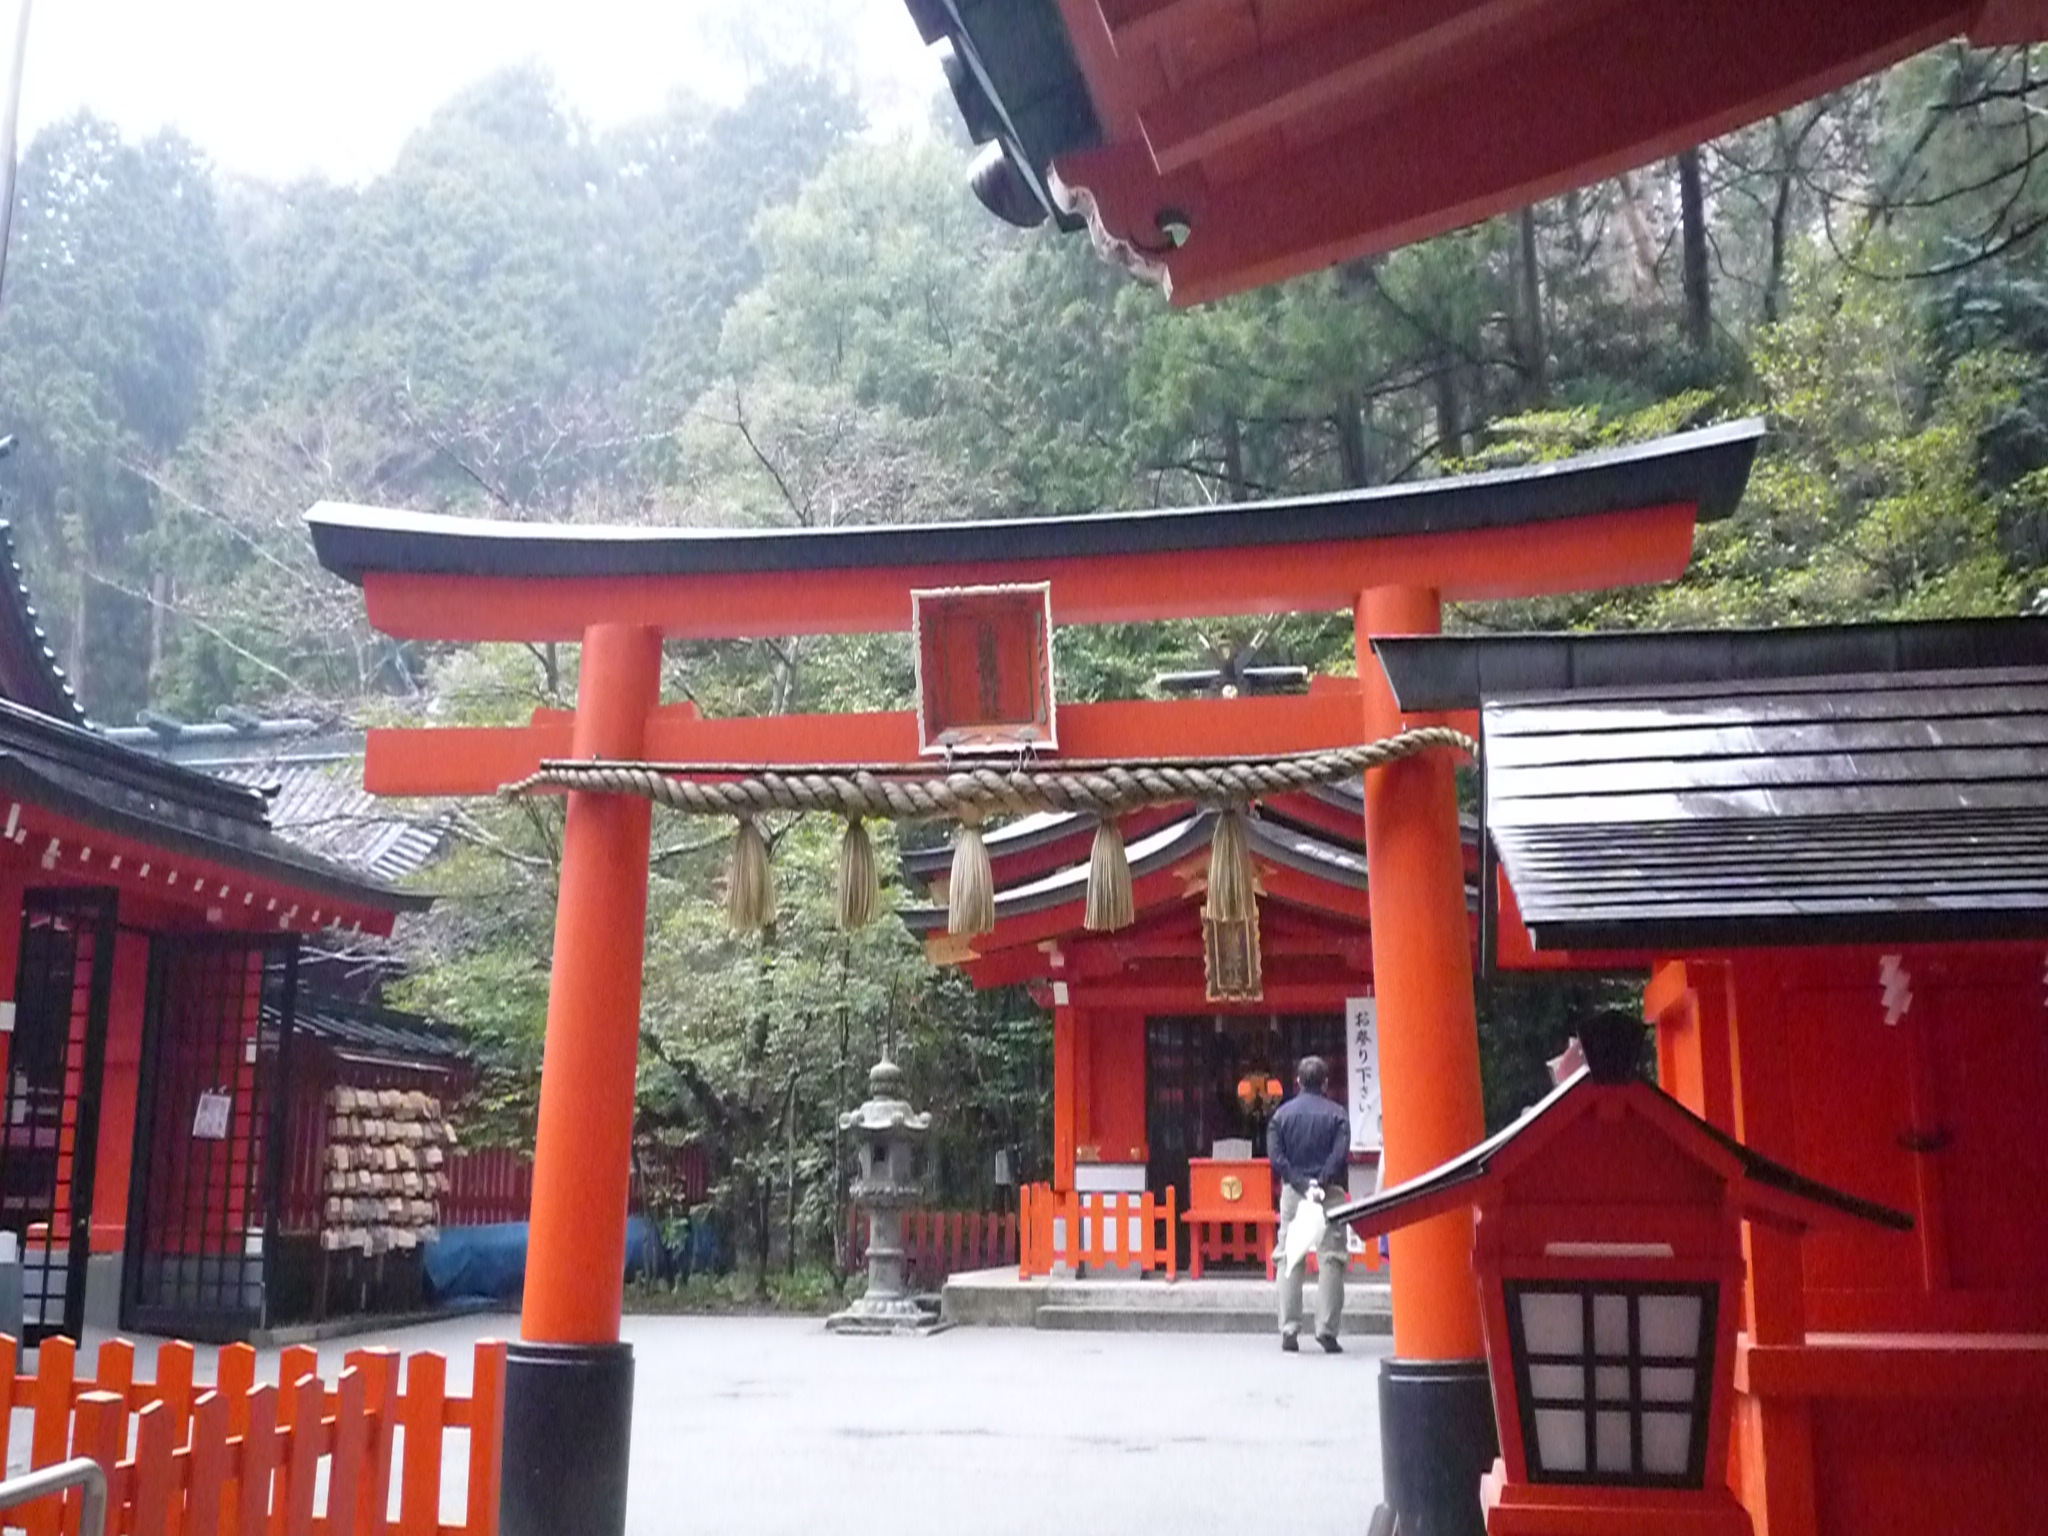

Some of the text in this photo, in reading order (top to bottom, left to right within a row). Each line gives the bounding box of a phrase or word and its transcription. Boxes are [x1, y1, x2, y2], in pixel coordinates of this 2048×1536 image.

[1355, 1011, 1371, 1112] お参り下さい
